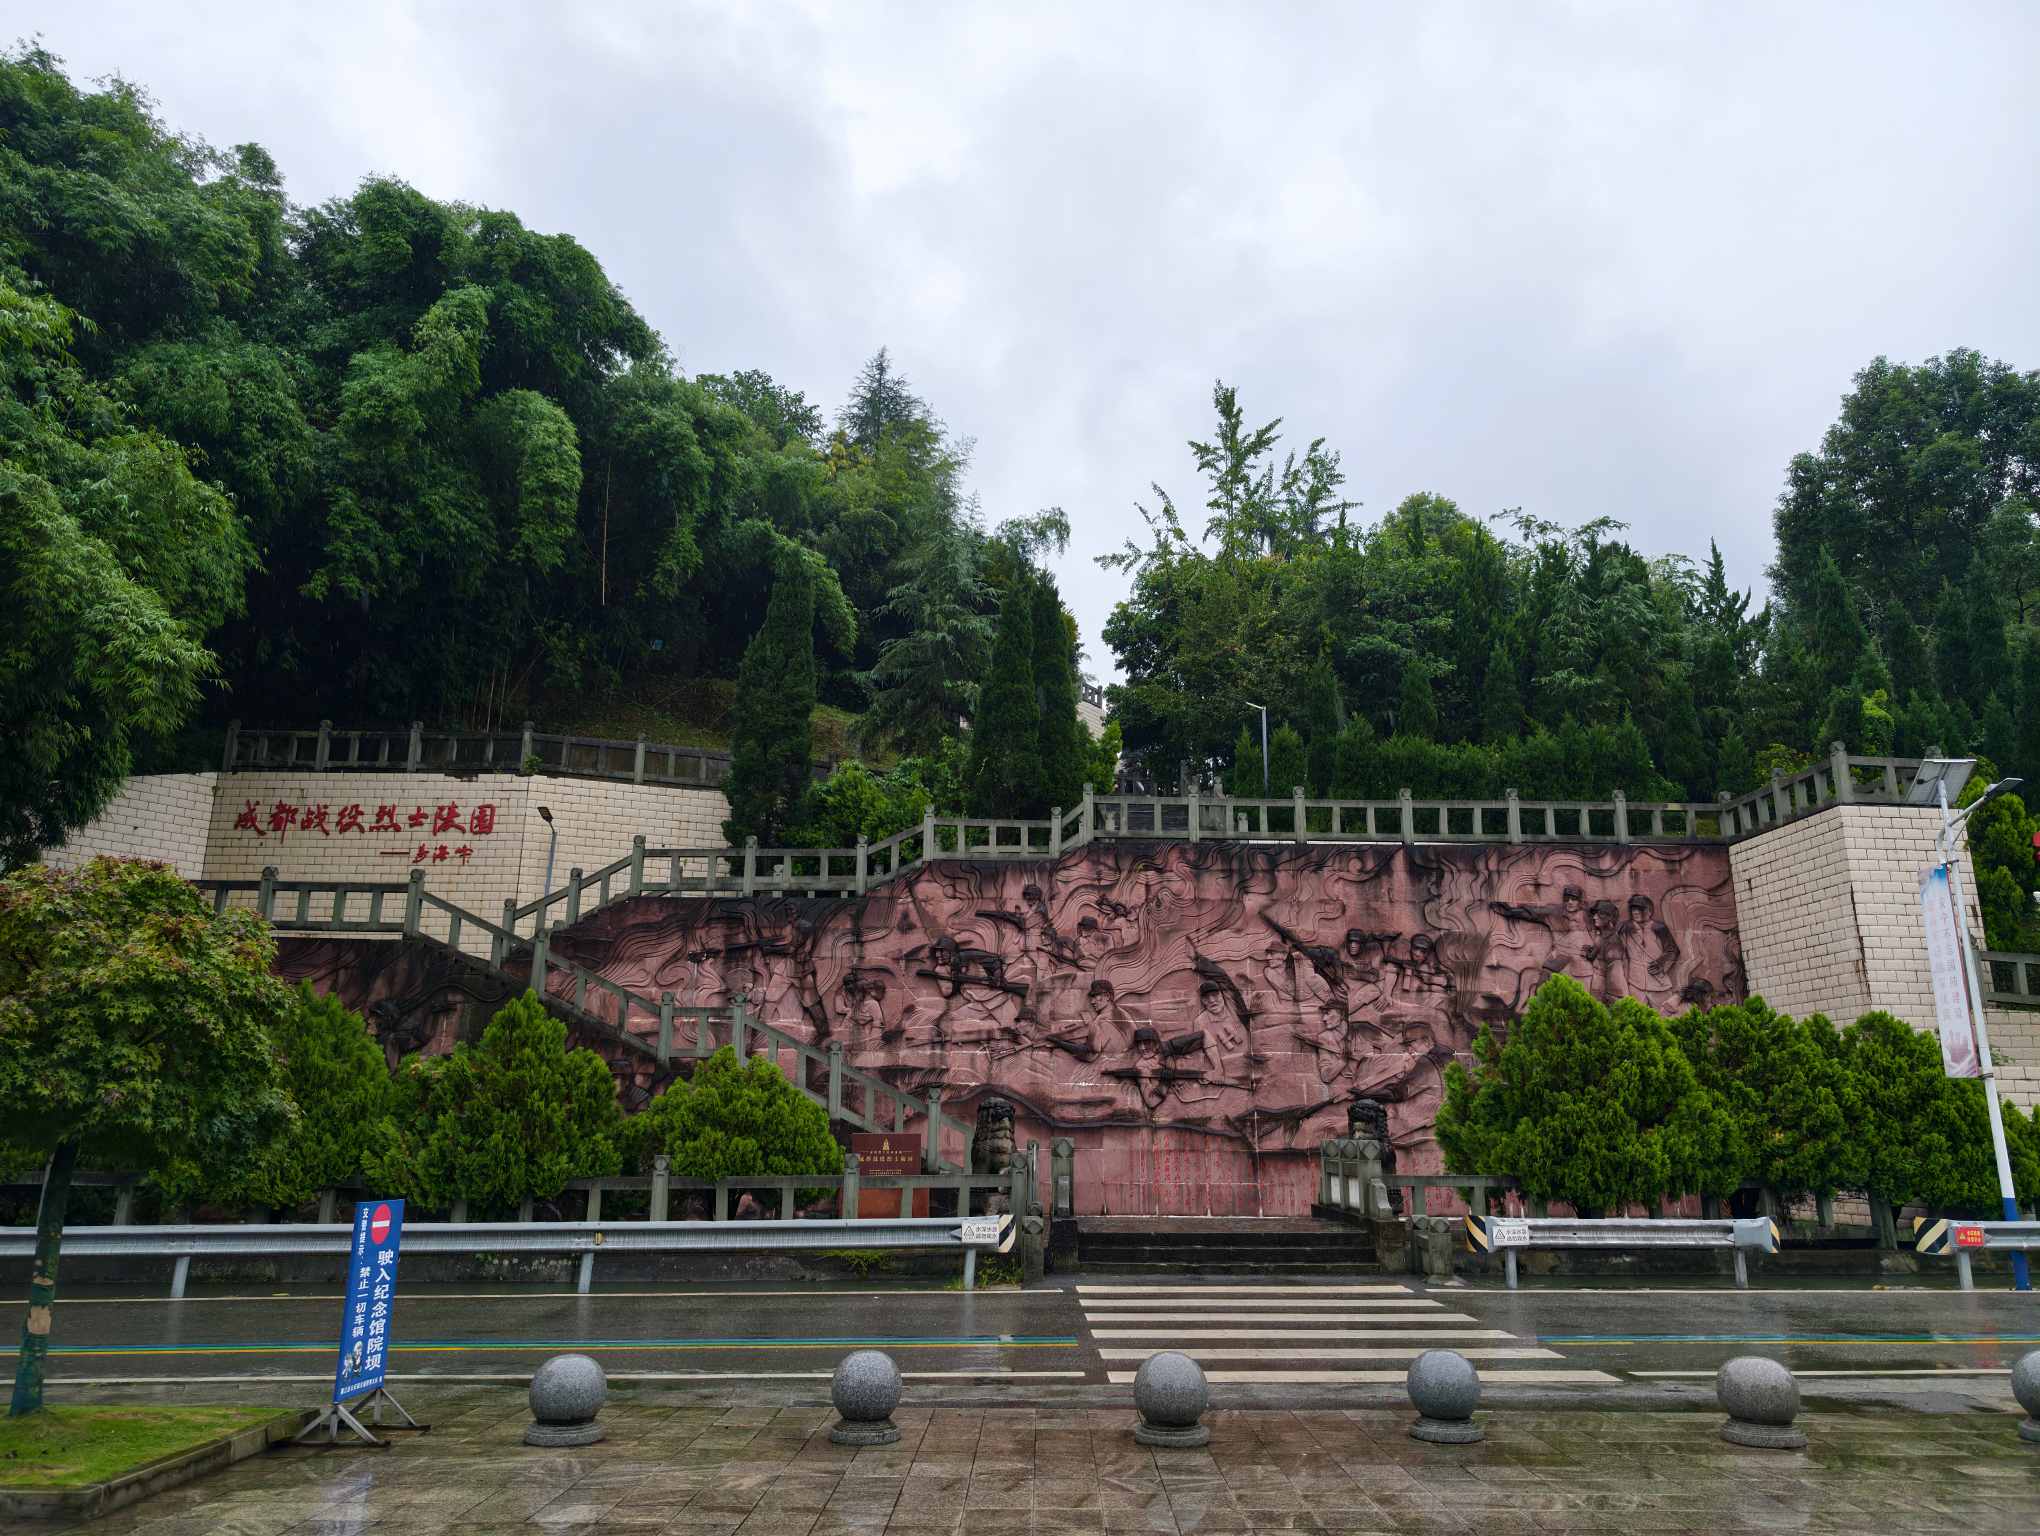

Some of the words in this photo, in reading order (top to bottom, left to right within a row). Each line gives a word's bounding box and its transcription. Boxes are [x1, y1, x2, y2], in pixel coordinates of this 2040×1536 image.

[233, 800, 497, 844] 成都战役烈士陵园
[364, 1249, 394, 1371] 驶入纪念馆院坝
